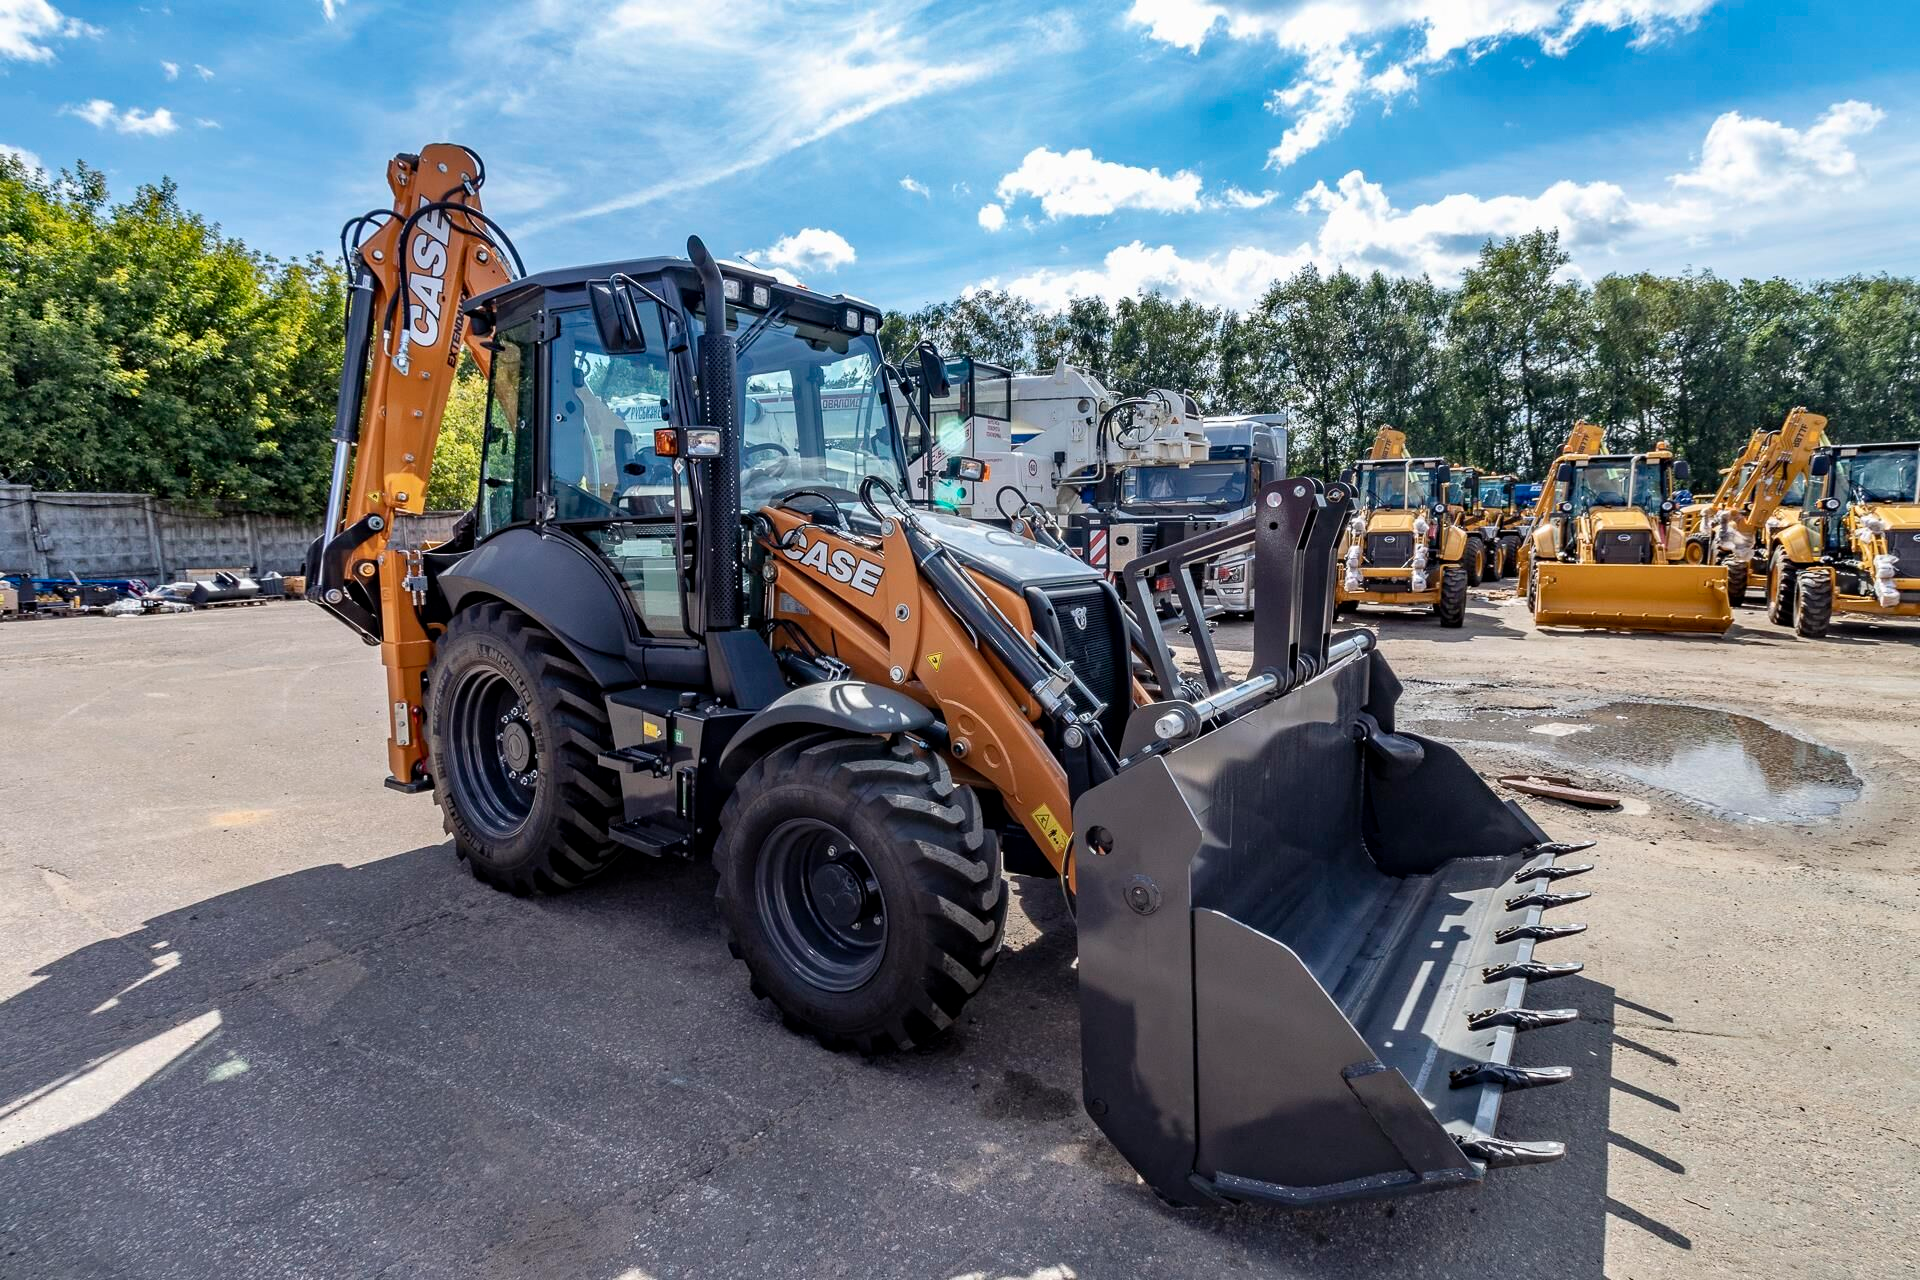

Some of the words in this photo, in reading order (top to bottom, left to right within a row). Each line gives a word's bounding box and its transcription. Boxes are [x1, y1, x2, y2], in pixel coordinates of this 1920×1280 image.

[409, 194, 452, 347] CASE
[781, 528, 886, 597] CASE
[488, 646, 532, 704] MICHELIN
